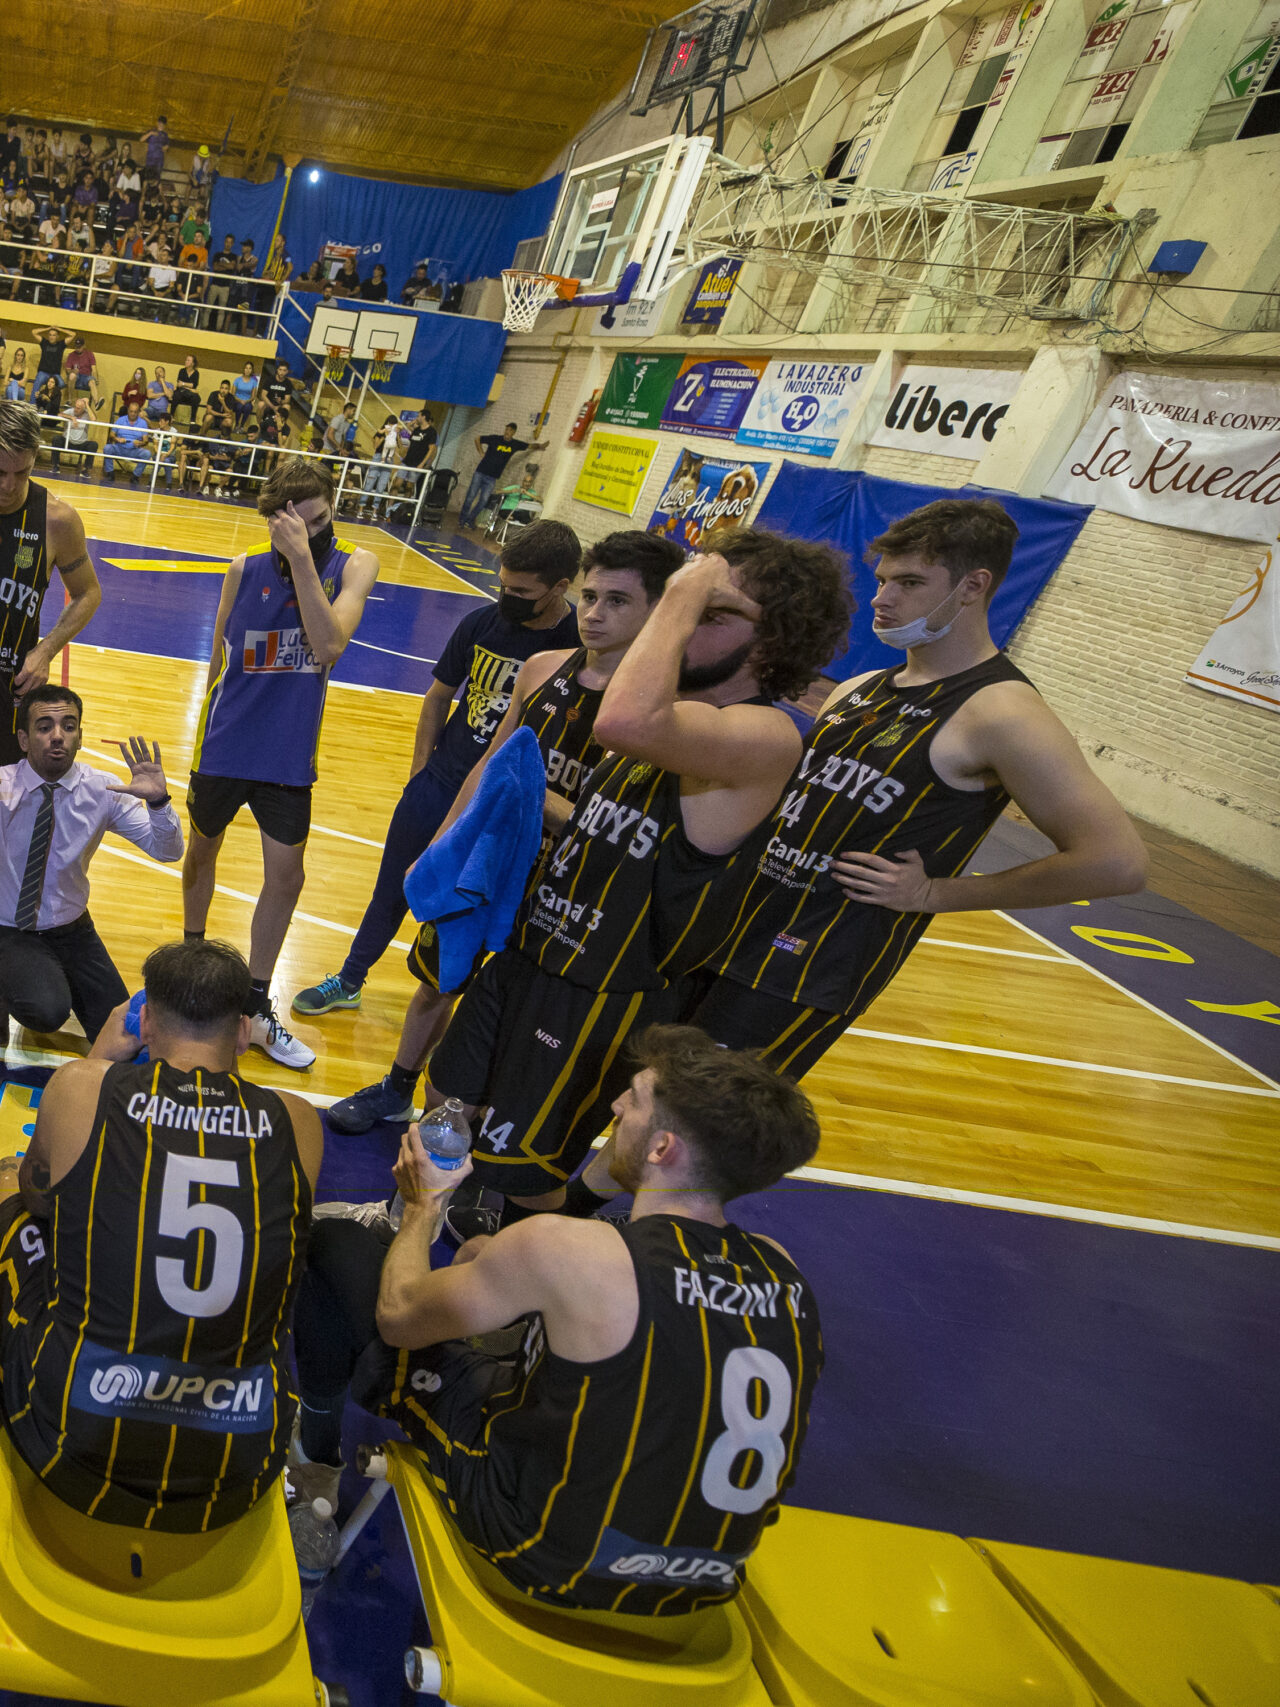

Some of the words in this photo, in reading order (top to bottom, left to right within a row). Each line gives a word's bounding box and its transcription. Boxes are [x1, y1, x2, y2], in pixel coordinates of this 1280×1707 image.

[777, 364, 862, 382] LAVADERO
[783, 380, 846, 396] INDUSTRIAL
[1108, 395, 1198, 424] PANADERIA
[1202, 409, 1218, 424] &
[497, 445, 512, 453] FILA
[1070, 426, 1131, 482] La
[660, 478, 694, 507] Los
[682, 486, 751, 529] Amigos
[278, 631, 310, 648] Luc
[542, 702, 557, 715] NR
[546, 748, 592, 792] BOY
[577, 792, 660, 859] BOYS
[813, 853, 834, 873] 3
[586, 909, 604, 931] 3
[535, 1028, 561, 1049] NRS
[127, 1092, 273, 1138] CARINGELLA
[19, 1224, 46, 1266] 5
[155, 1150, 245, 1319] 5
[674, 1266, 780, 1318] FAZZINI
[143, 1370, 264, 1412] UPCN
[221, 1412, 230, 1421] LA
[701, 1346, 792, 1514] 8
[663, 1554, 736, 1584] UP
